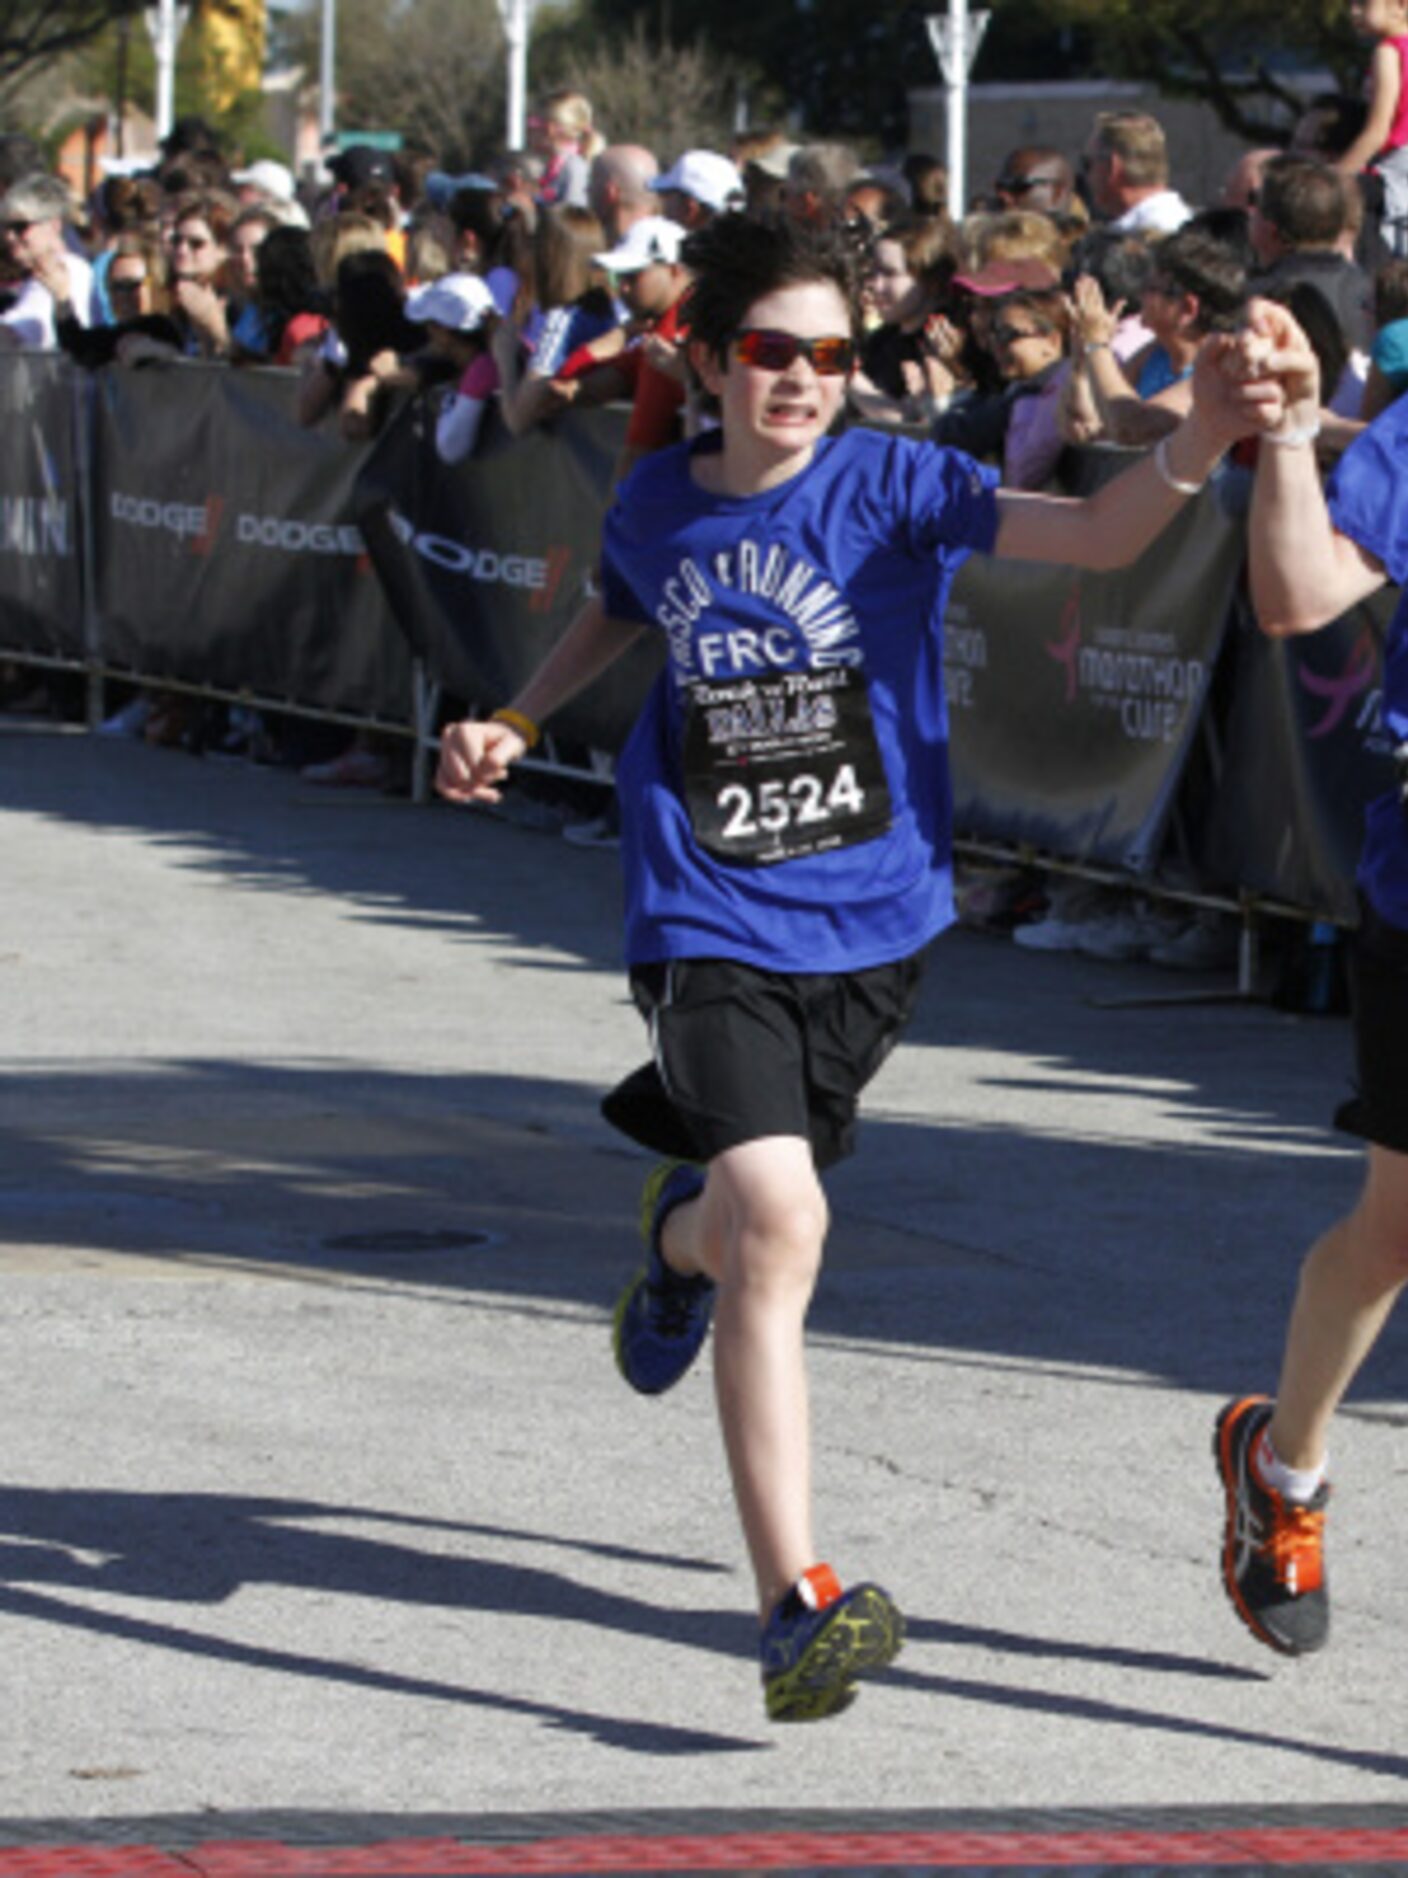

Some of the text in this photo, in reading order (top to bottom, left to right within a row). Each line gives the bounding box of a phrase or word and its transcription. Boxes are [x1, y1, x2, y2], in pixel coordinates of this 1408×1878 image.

[739, 538, 863, 669] RUNNING
[699, 627, 795, 677] FRC
[717, 764, 866, 839] 2524
